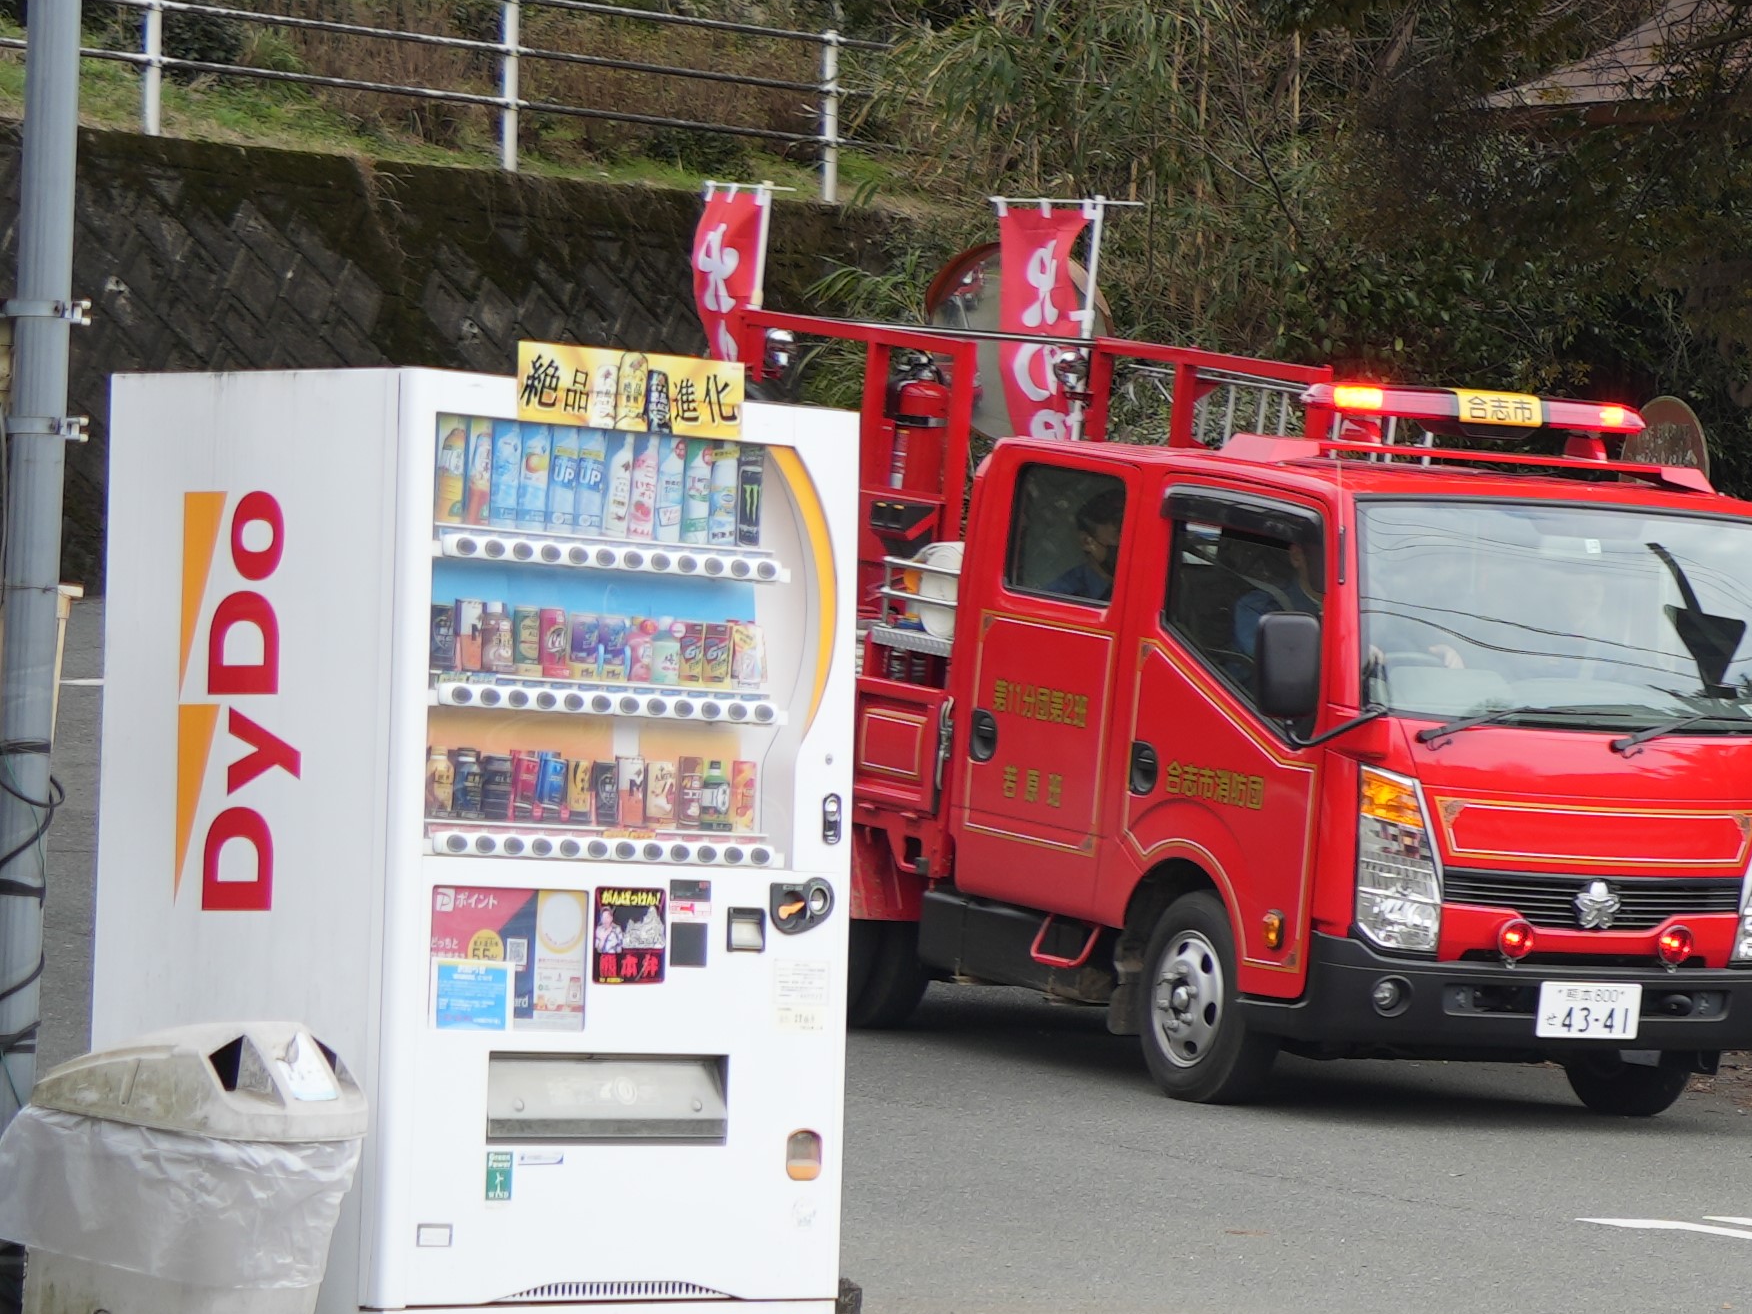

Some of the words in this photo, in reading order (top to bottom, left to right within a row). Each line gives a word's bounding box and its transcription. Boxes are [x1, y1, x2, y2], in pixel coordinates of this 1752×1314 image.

[520, 353, 589, 414] 絶品
[673, 373, 738, 425] 進化
[1467, 395, 1534, 423] 合志市
[201, 490, 302, 912] DyDo
[992, 678, 1089, 729] 第11分団第2班
[1165, 760, 1265, 810] 合志市消防団
[456, 892, 498, 910] ポイント
[1561, 1006, 1629, 1035] 43-41
